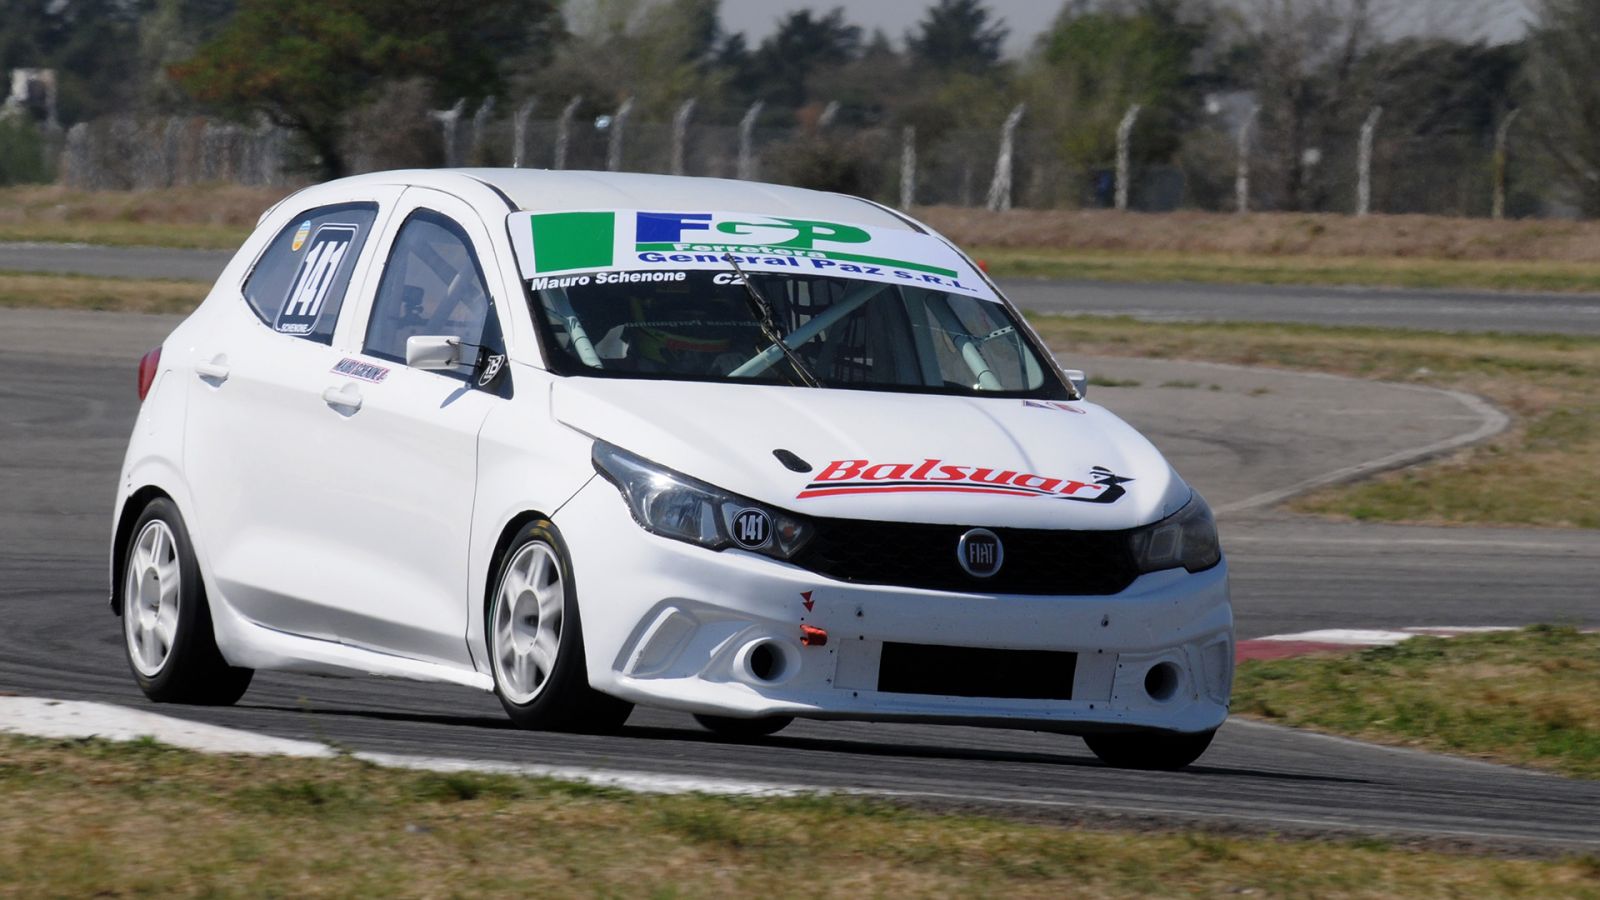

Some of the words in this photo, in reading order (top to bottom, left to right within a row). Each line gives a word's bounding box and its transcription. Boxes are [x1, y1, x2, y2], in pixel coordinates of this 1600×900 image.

[637, 251, 800, 267] General
[810, 258, 885, 276] Paz
[672, 243, 828, 259] Ferretera
[284, 240, 349, 317] 141
[531, 276, 590, 291] Mauro
[595, 270, 687, 285] Schenone
[813, 458, 1102, 496] Balsuar
[738, 514, 764, 541] 141
[970, 542, 995, 565] FIAT
